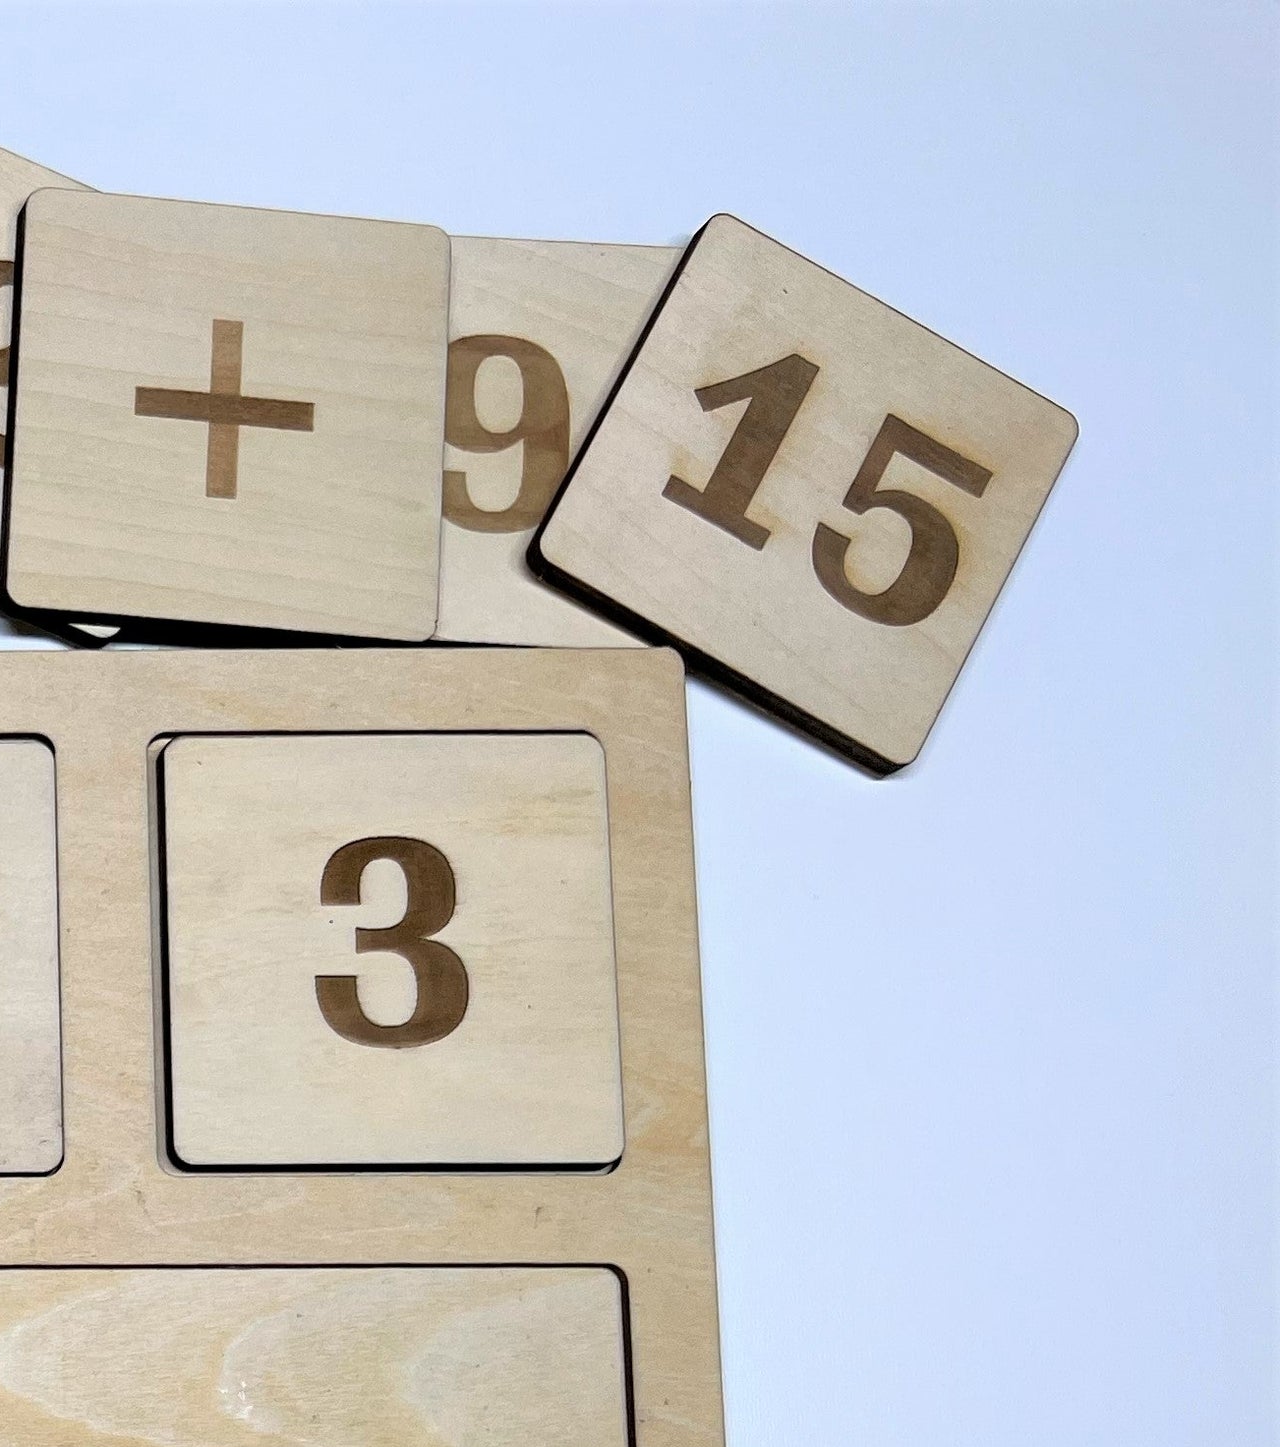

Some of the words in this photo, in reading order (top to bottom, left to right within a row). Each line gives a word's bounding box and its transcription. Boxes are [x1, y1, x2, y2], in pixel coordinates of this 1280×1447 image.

[134, 319, 314, 498] +
[662, 353, 991, 627] 15
[314, 835, 470, 1050] 3
